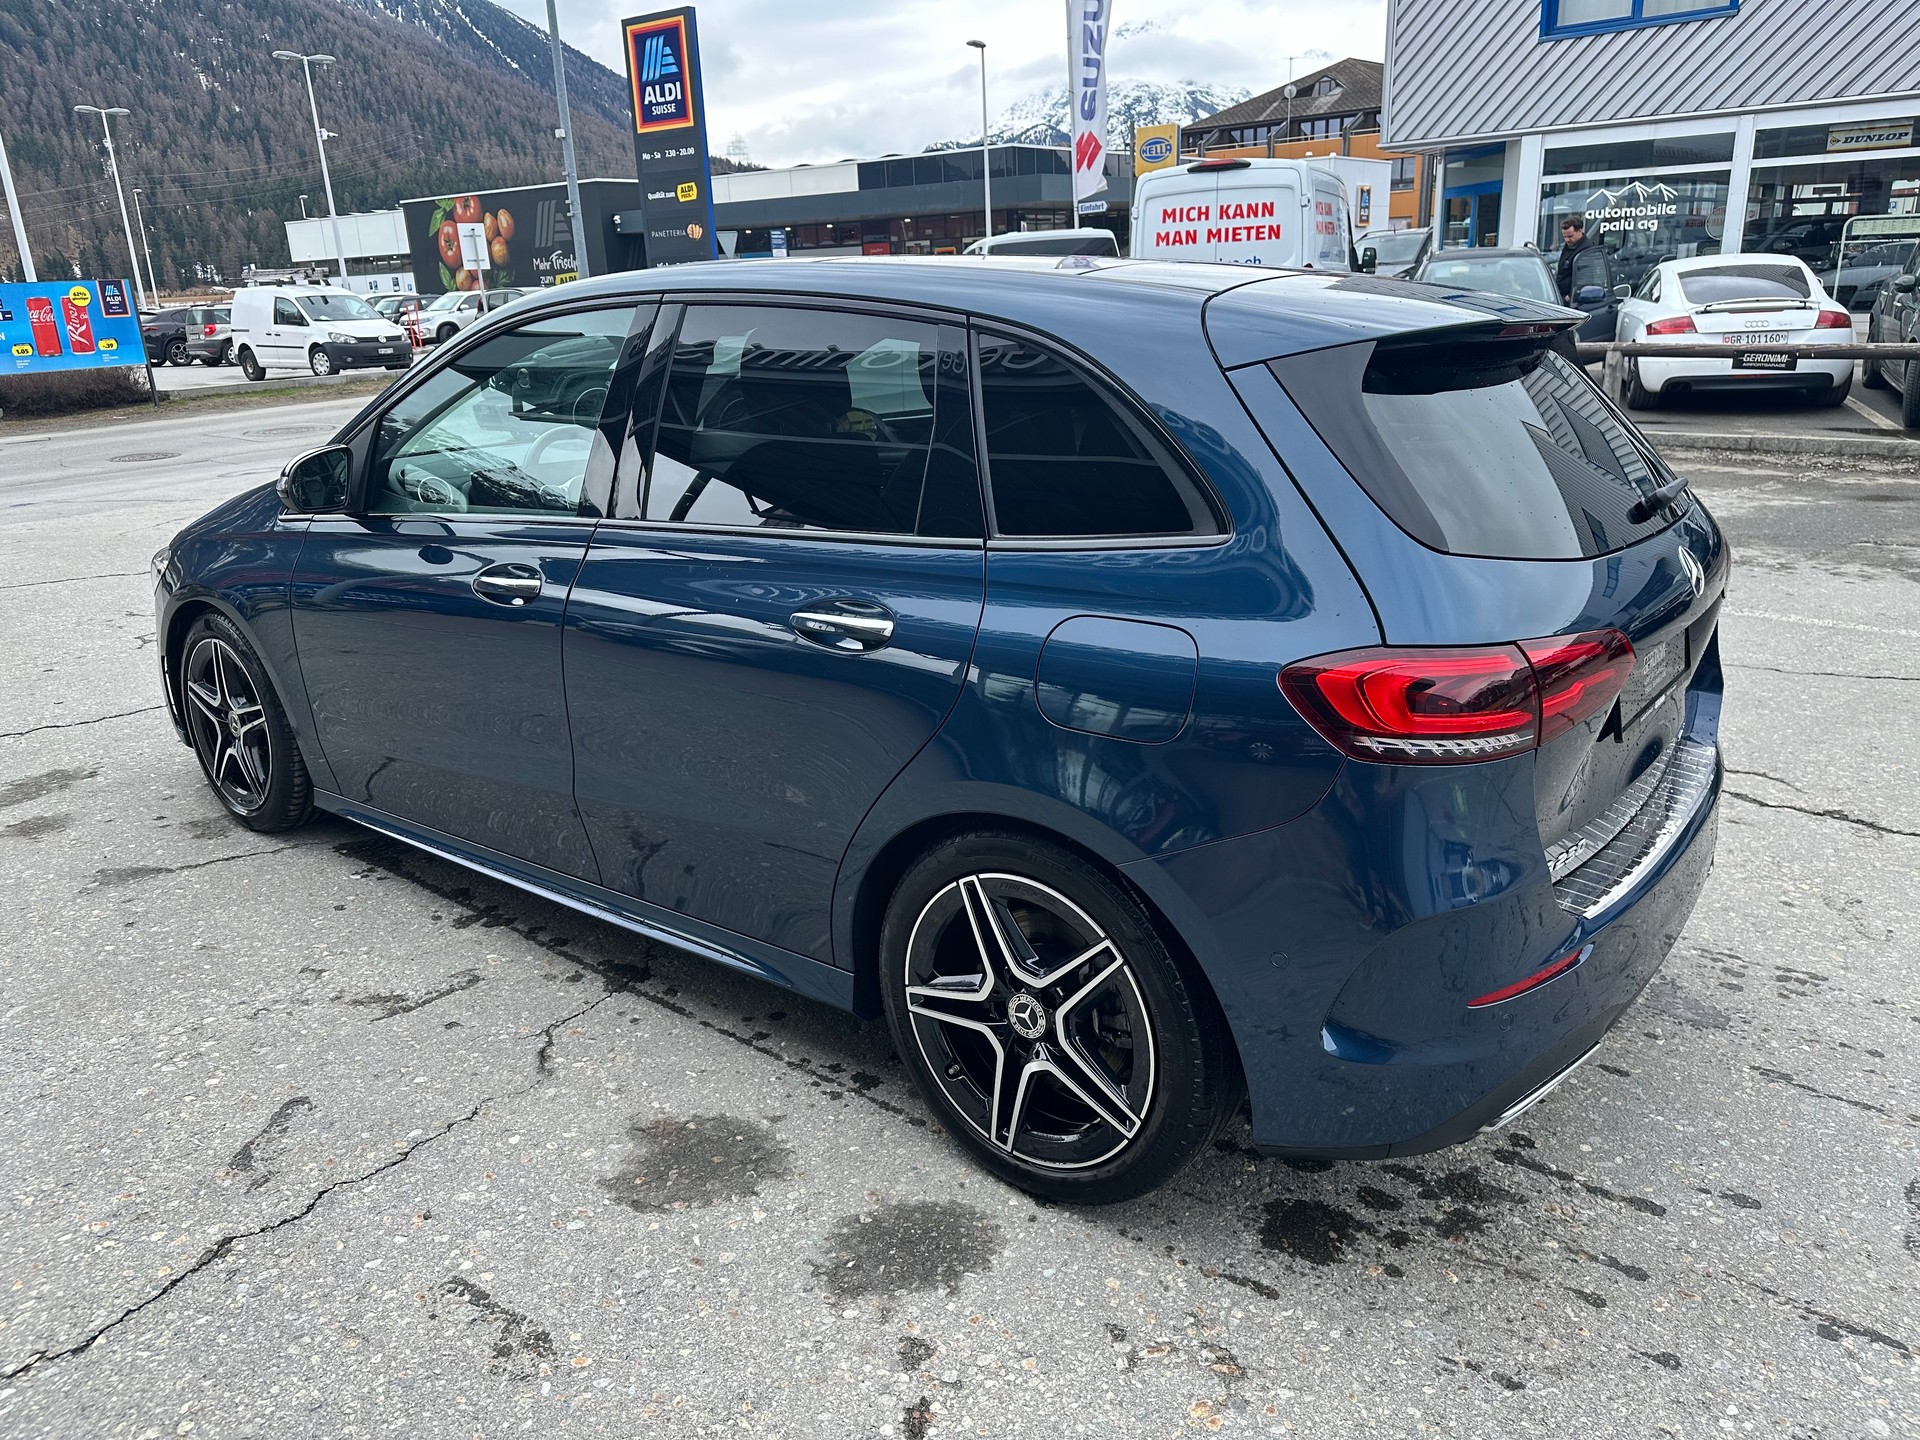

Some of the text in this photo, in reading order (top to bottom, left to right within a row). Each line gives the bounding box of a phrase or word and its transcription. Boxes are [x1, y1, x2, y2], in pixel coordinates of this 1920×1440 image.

[644, 81, 682, 104] ALDI
[651, 103, 677, 115] SUISSE
[1841, 132, 1909, 144] DUNLOP
[1142, 143, 1172, 156] HELLA
[680, 184, 694, 194] ALDI
[1080, 202, 1105, 213] Einfahrt
[1161, 201, 1275, 224] MICH KANN
[1585, 203, 1677, 219] automobile
[1600, 217, 1658, 234] palü ag
[651, 229, 686, 238] PANETTERIA
[1155, 224, 1281, 247] MAN MIETEN
[532, 249, 577, 272] Mehr Frisch
[540, 275, 555, 284] zum
